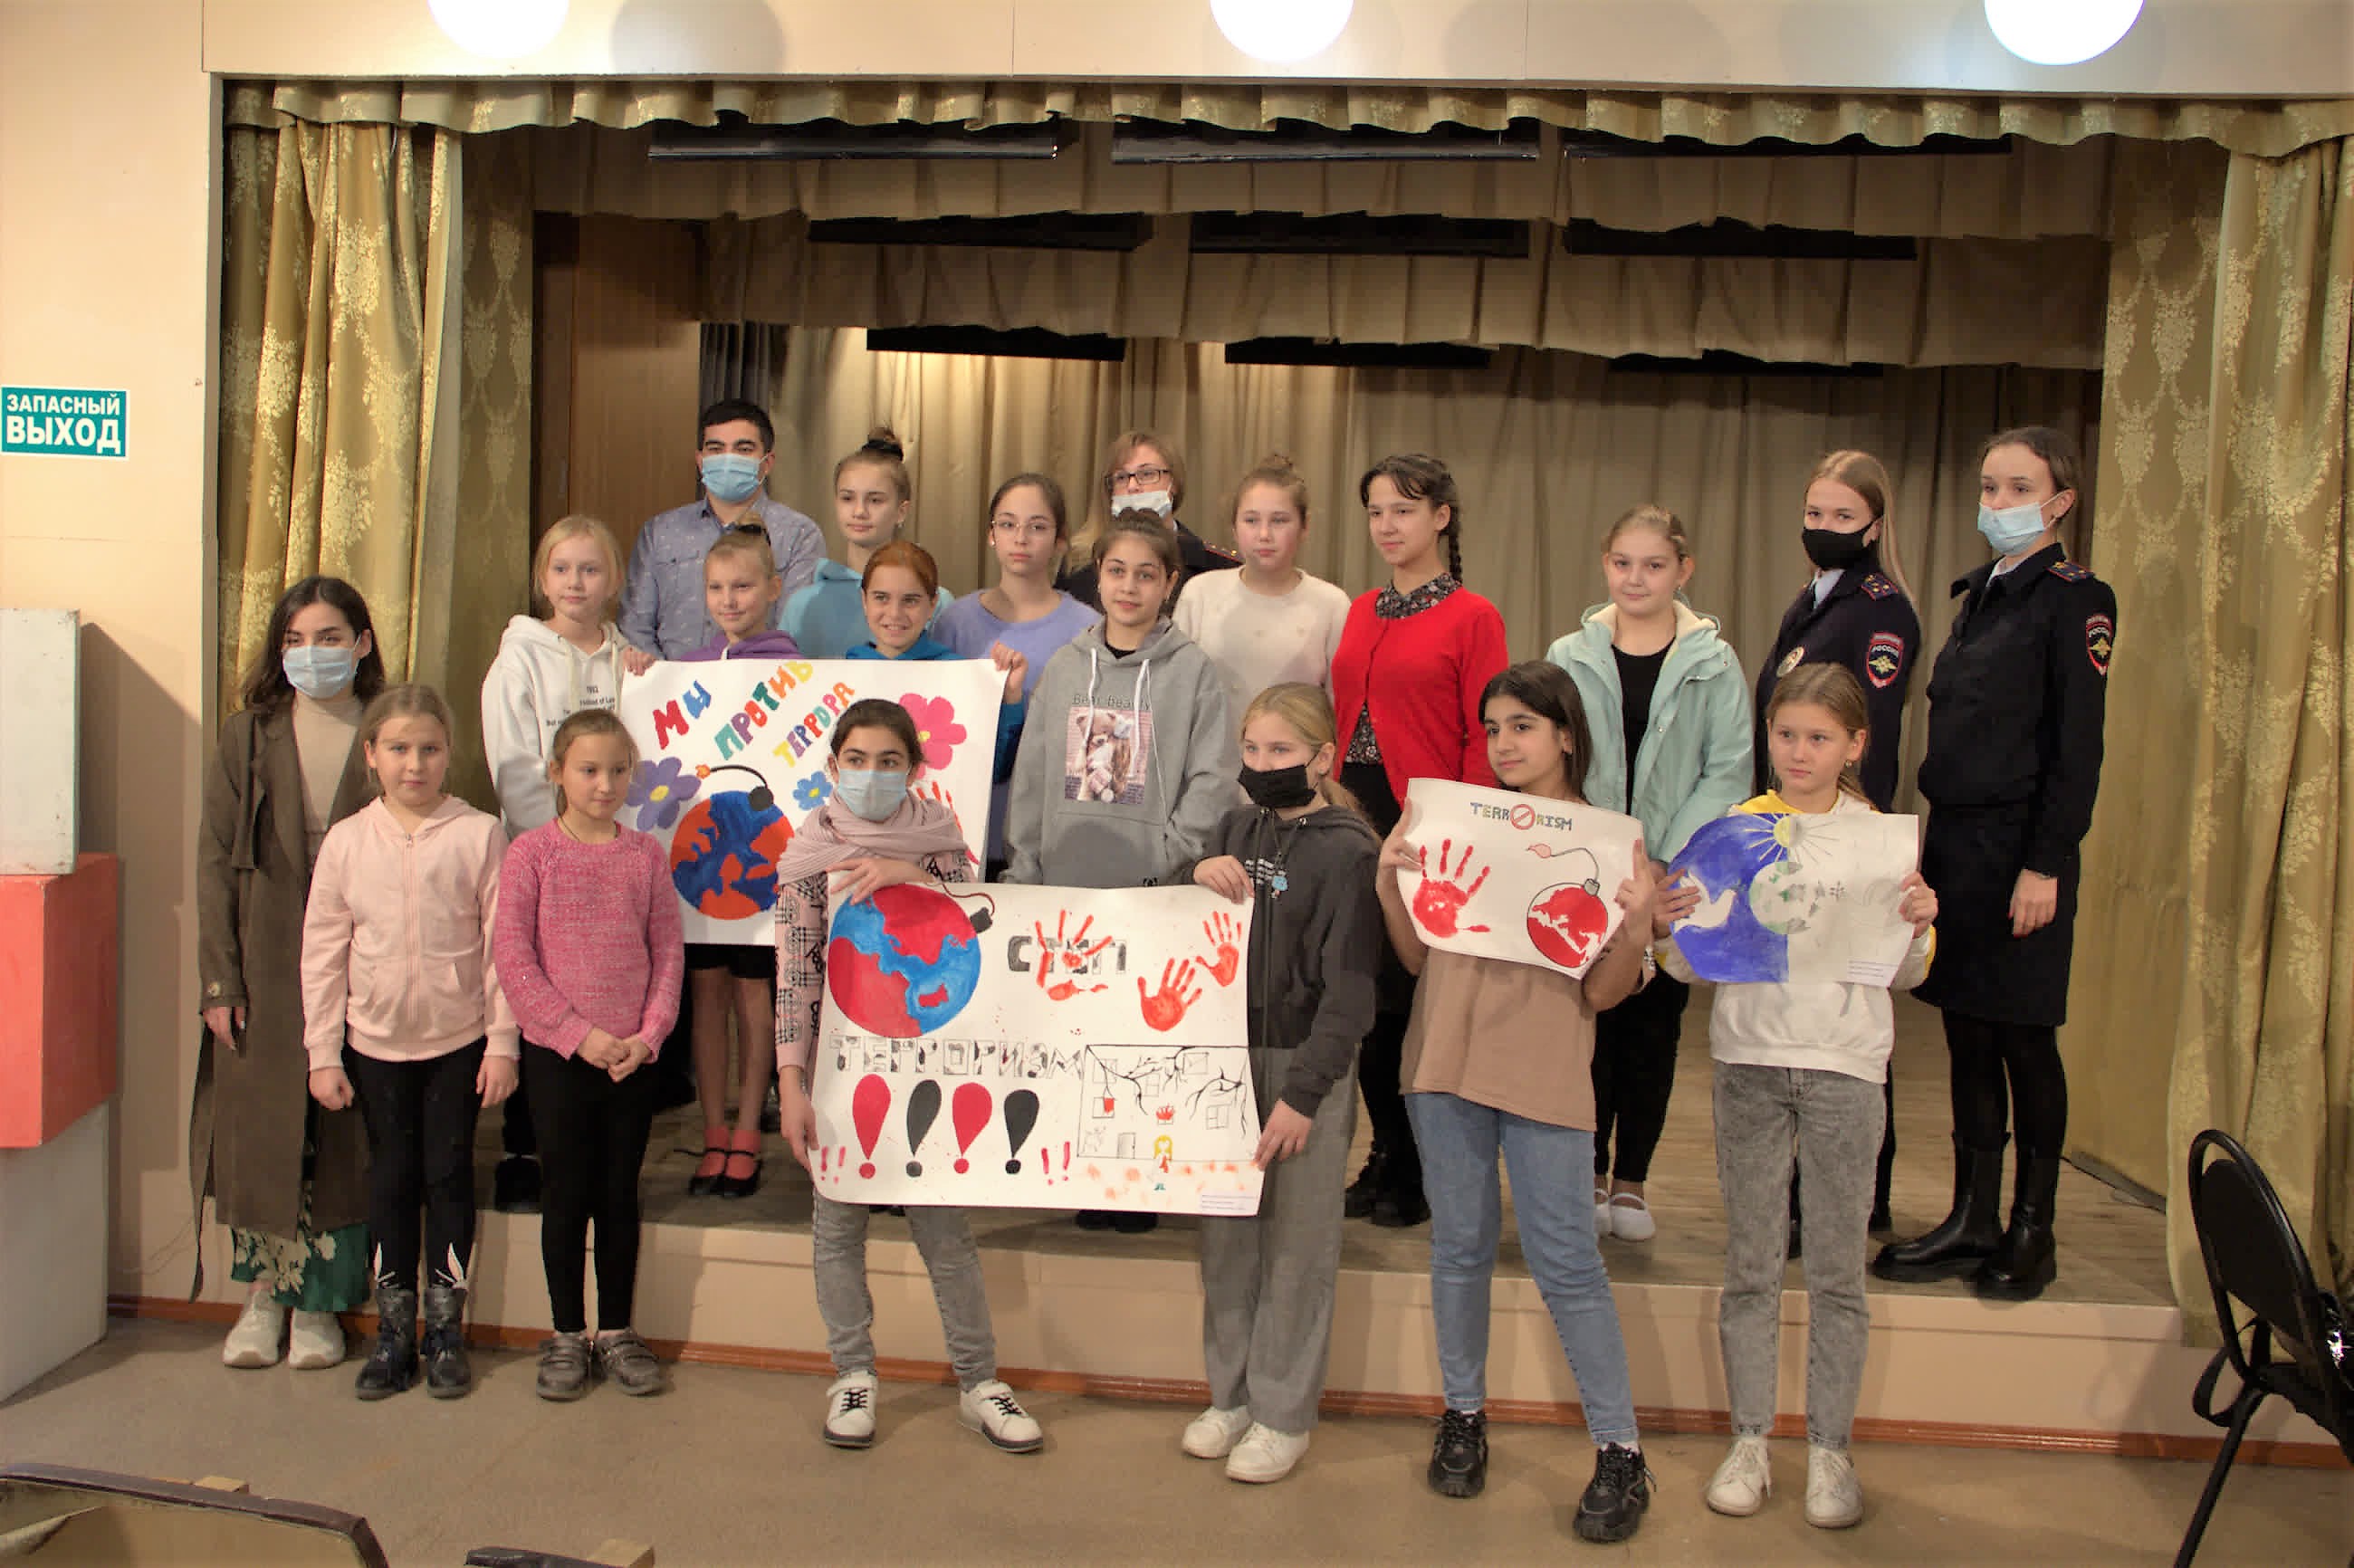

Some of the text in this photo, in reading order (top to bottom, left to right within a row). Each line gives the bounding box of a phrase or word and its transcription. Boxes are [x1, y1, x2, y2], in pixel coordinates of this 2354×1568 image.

[6, 393, 120, 416] ЗАПАСНЫЙ
[6, 416, 121, 454] ВЫХОД
[653, 680, 712, 750] МЫ
[714, 661, 814, 761] ПРОТИВ
[772, 682, 856, 769] ТЕРРОРА
[1469, 801, 1574, 831] TERRORISM
[829, 1034, 1085, 1080] ТЕРРОРИЗМ
